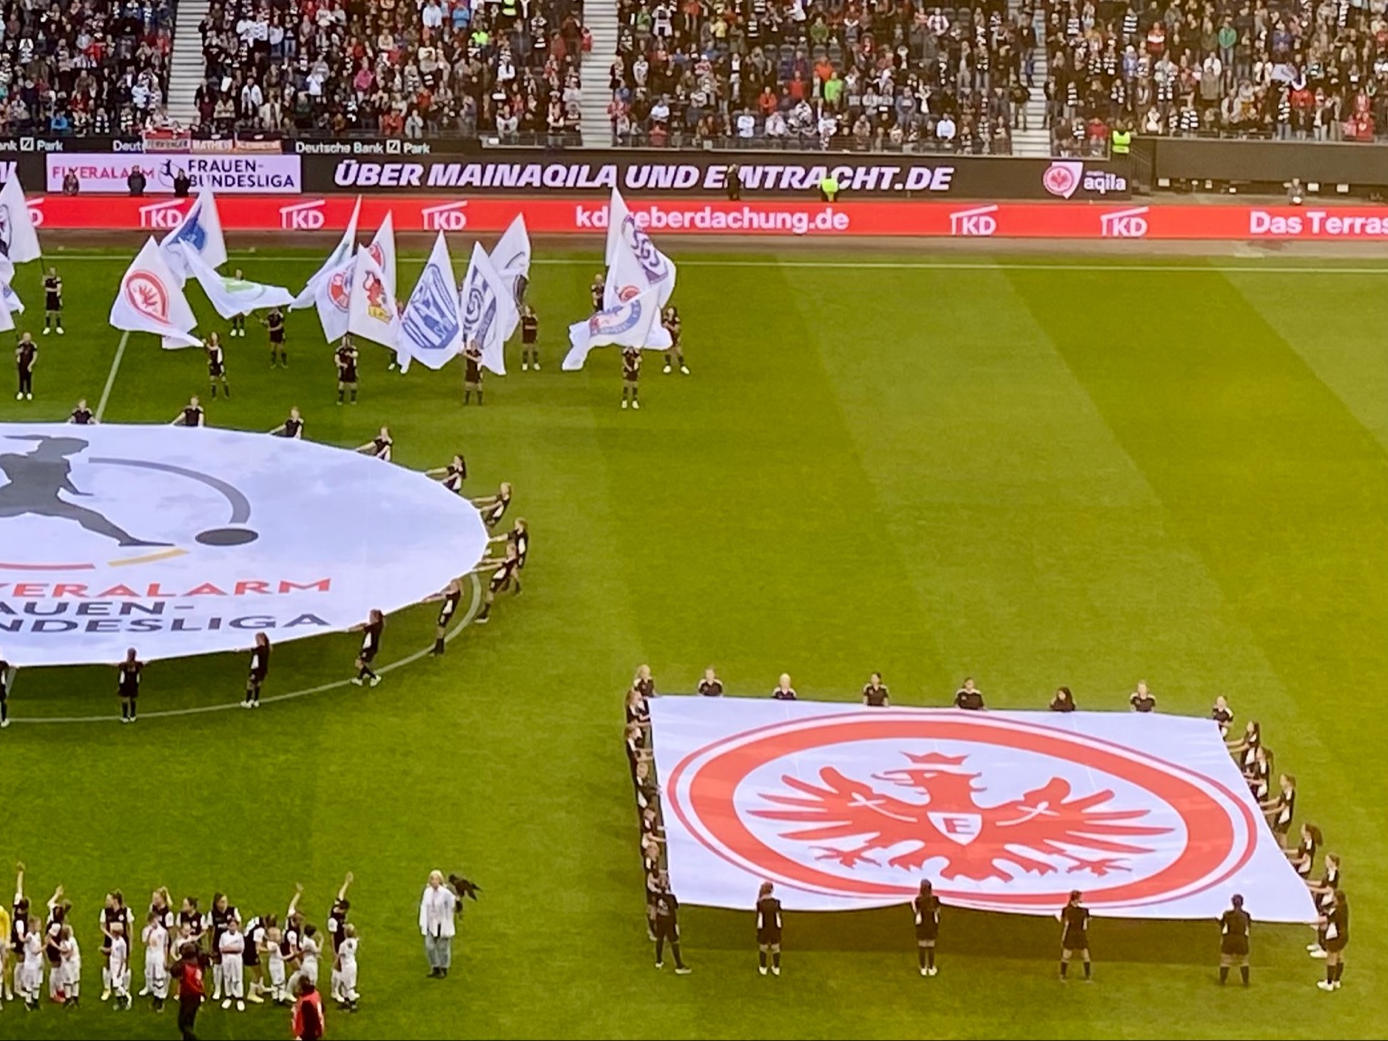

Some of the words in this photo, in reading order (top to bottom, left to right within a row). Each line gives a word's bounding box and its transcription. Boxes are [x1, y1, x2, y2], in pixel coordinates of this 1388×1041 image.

[37, 140, 62, 150] Park
[296, 142, 351, 153] Deutsche
[354, 142, 383, 153] Bank
[404, 143, 429, 153] Park
[53, 166, 155, 179] FLYERALAM
[189, 160, 264, 172] FRAUEN-
[334, 160, 423, 186] ÜBER
[427, 163, 617, 188] MAINAQILA
[625, 164, 700, 189] UND
[705, 164, 954, 191] ENTRACHT.DE
[1084, 174, 1126, 194] aqila
[576, 207, 849, 234] kdeberdachung.de
[1250, 211, 1303, 234] Das
